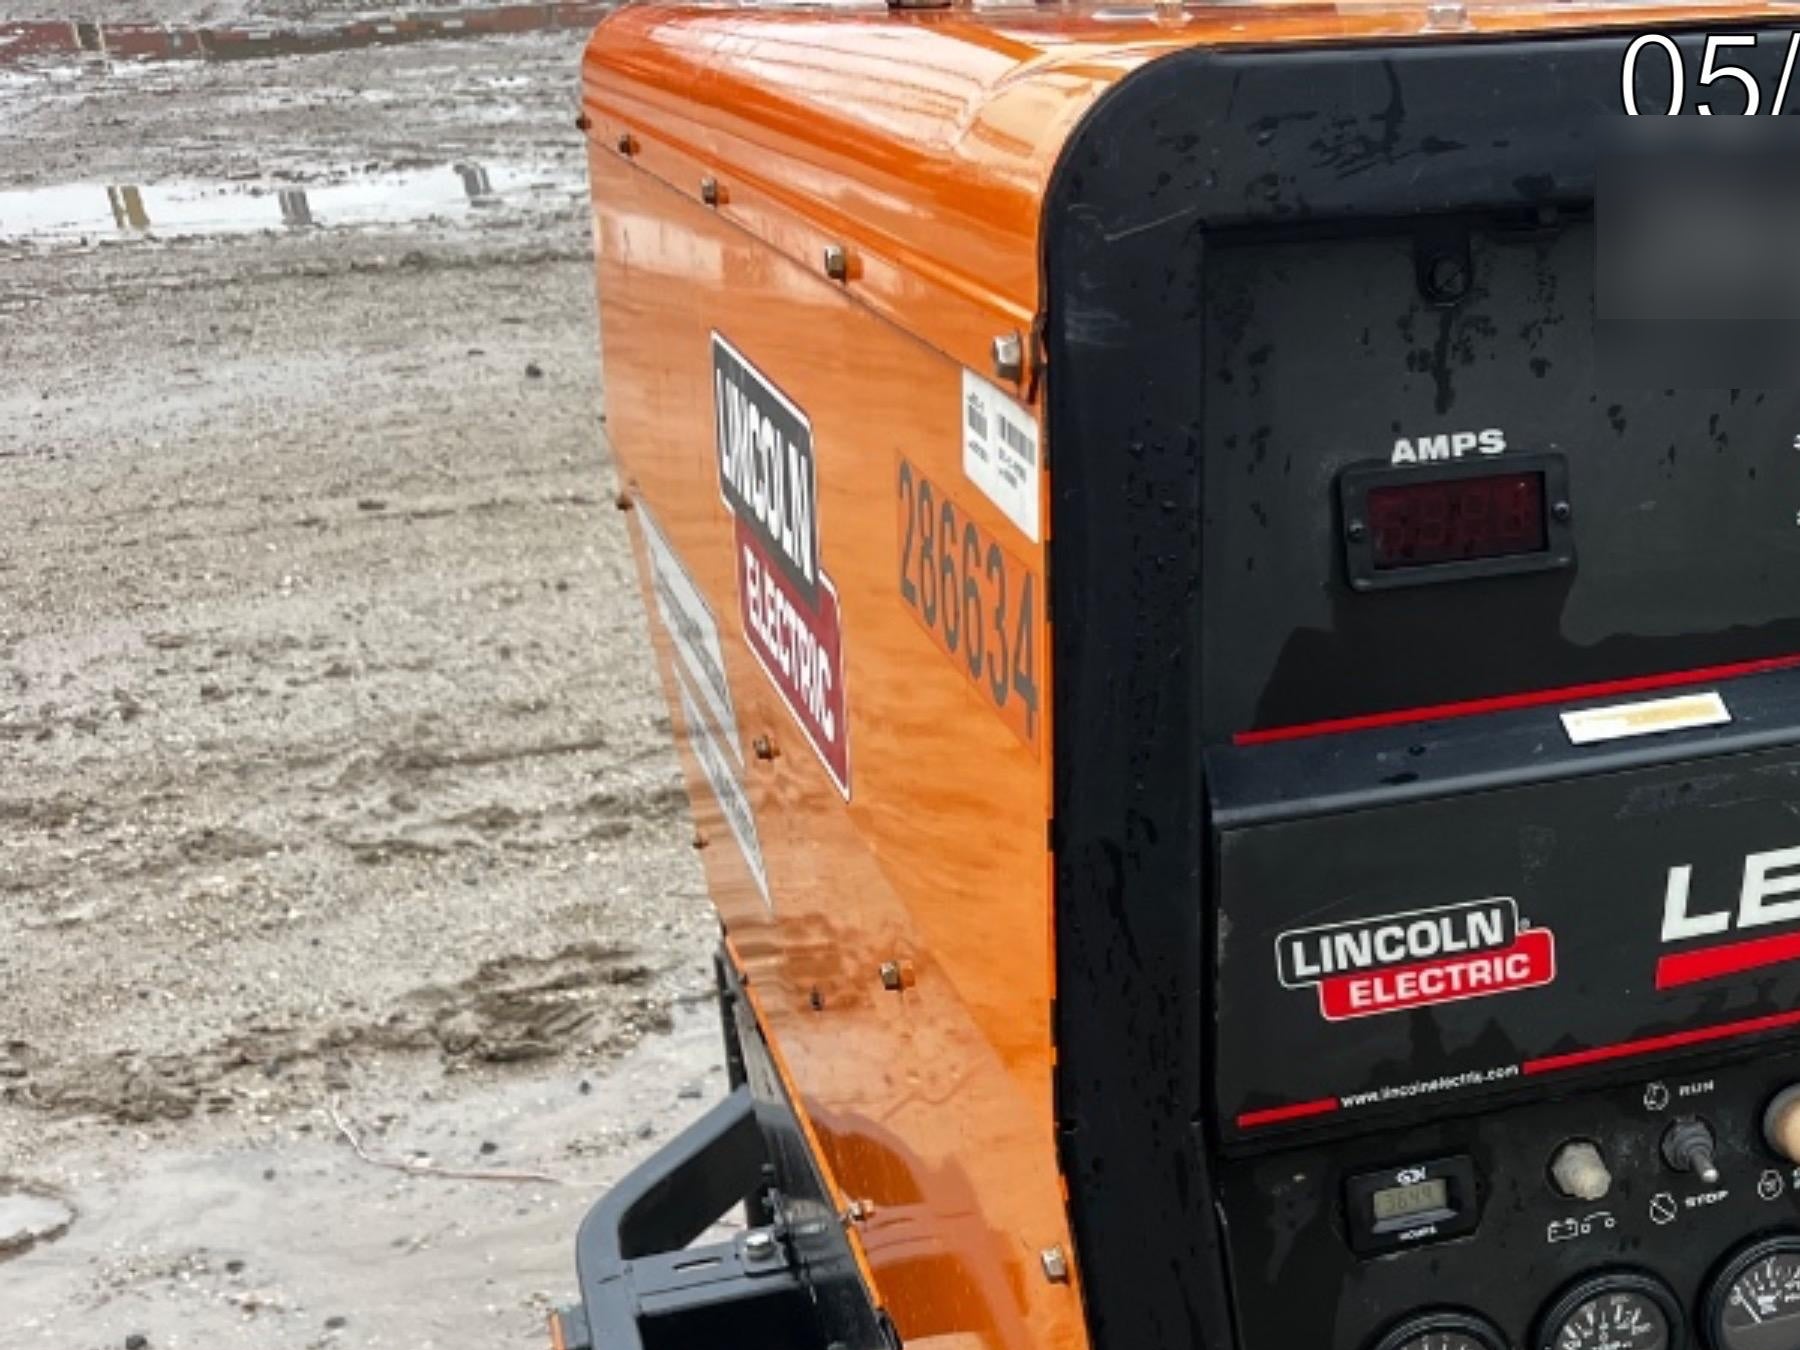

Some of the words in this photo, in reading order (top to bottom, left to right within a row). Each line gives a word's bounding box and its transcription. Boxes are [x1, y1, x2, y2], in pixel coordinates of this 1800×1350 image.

[1391, 427, 1507, 465] AMPS
[716, 367, 814, 586] LINCOLN
[899, 457, 1040, 741] 286634
[743, 543, 836, 743] ELECTRIC
[1290, 902, 1505, 976] LINCOLN
[1347, 950, 1533, 1010] ELECTRIC
[1340, 1063, 1519, 1109] www.lincolnelectric.com
[1679, 1080, 1715, 1097] RUN
[1684, 1190, 1730, 1209] STOP
